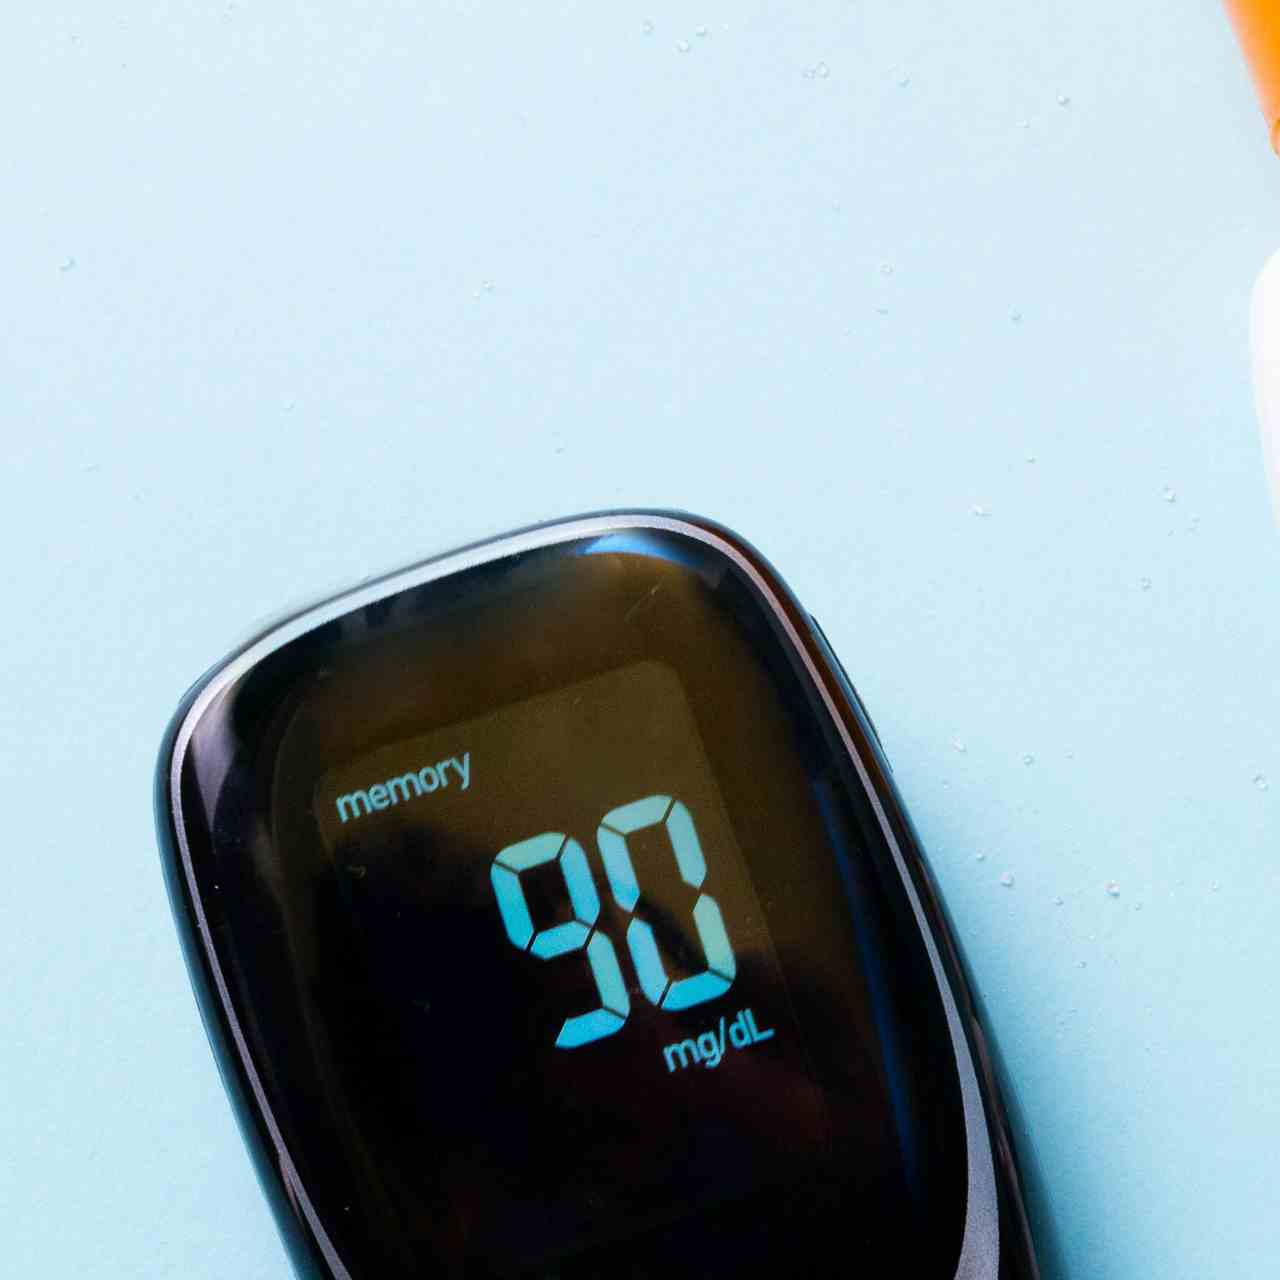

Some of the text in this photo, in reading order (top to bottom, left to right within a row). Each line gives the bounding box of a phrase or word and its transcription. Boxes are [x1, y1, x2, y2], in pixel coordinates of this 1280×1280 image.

[336, 752, 472, 823] memory
[490, 795, 737, 1050] 90
[662, 1008, 775, 1074] mg/dL
